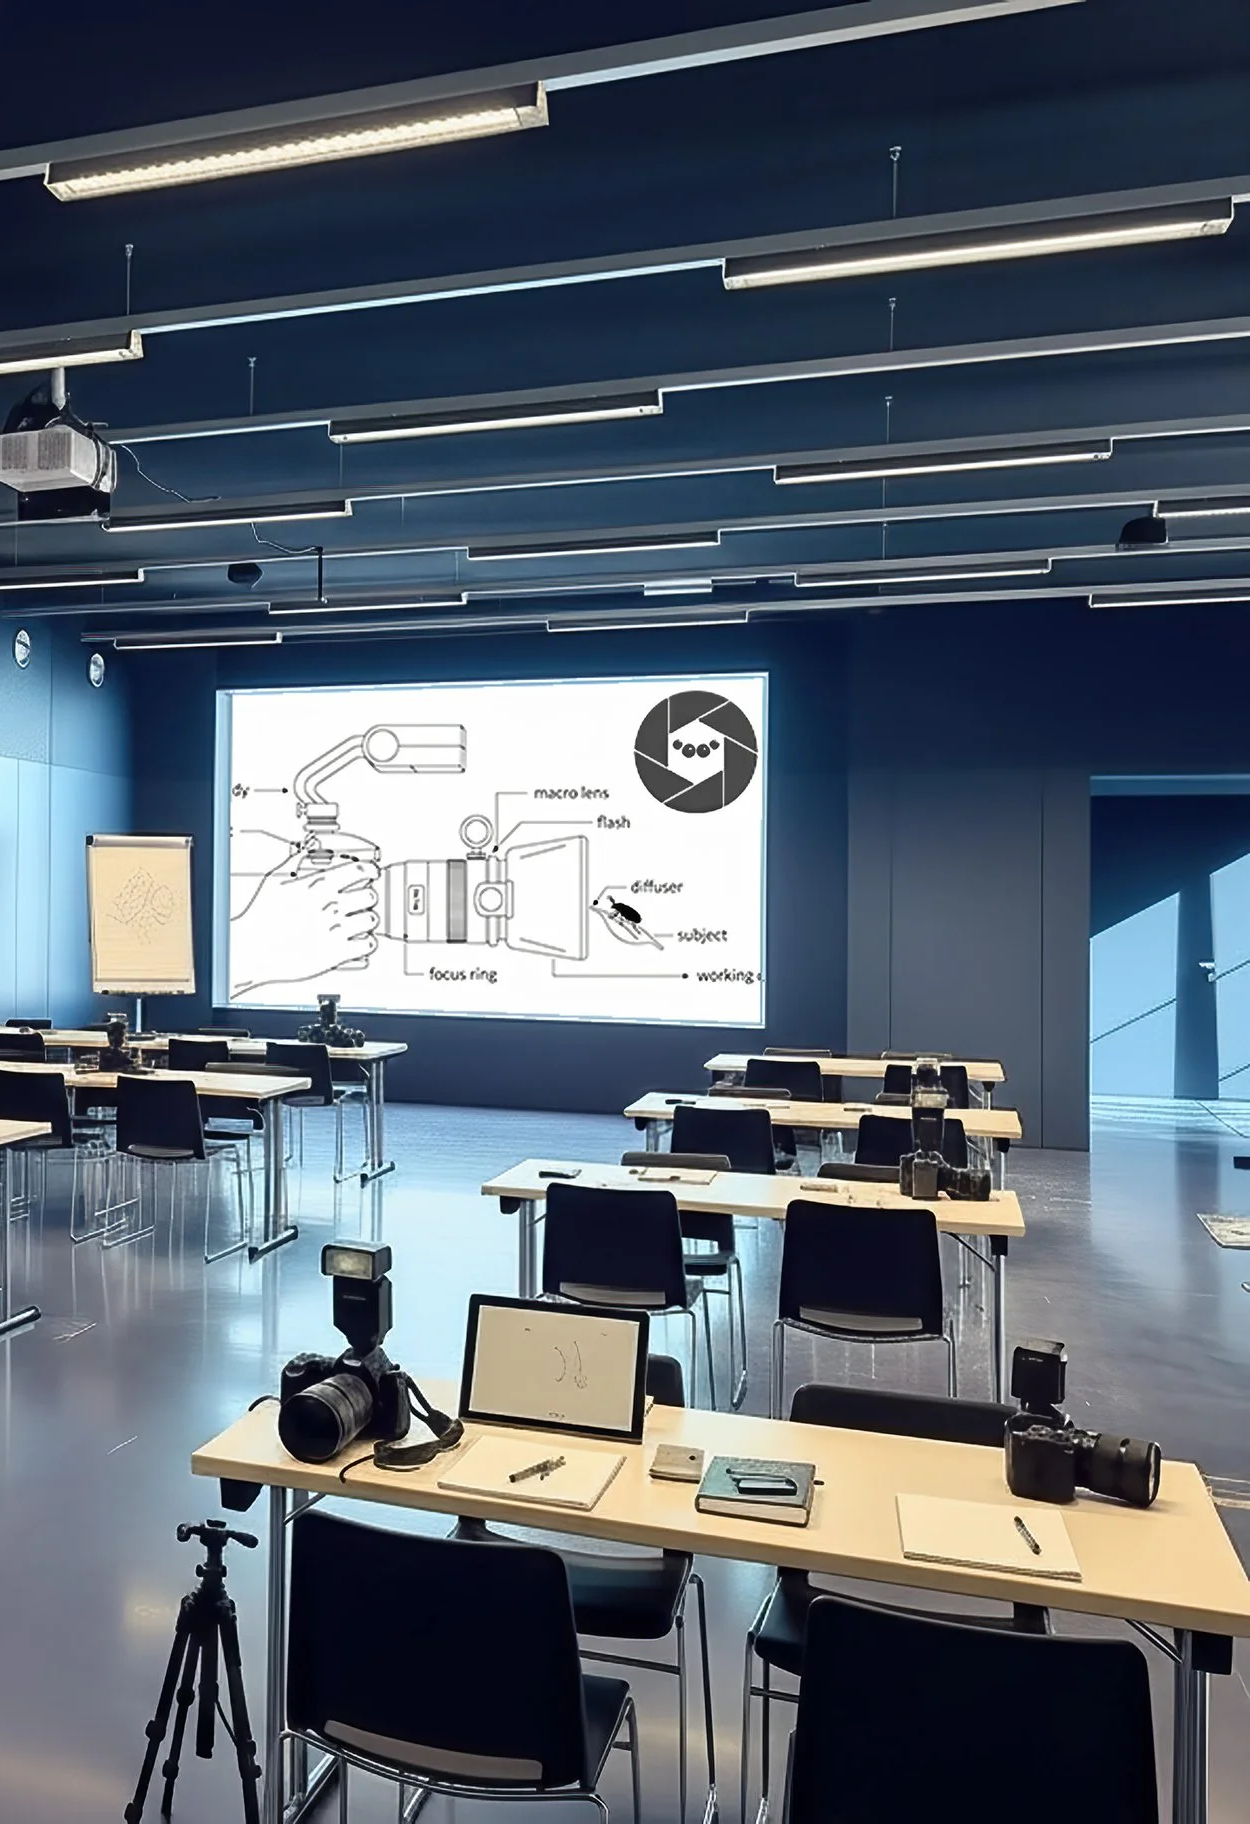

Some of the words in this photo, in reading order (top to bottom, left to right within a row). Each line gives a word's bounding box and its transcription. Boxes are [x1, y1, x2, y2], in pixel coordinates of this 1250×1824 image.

[533, 788, 579, 800] macro
[580, 785, 610, 800] lens
[596, 814, 631, 830] flash
[630, 879, 684, 894] diffuser
[677, 928, 728, 945] subject
[429, 966, 467, 981] focus
[469, 966, 498, 985] ring
[696, 968, 755, 985] working
